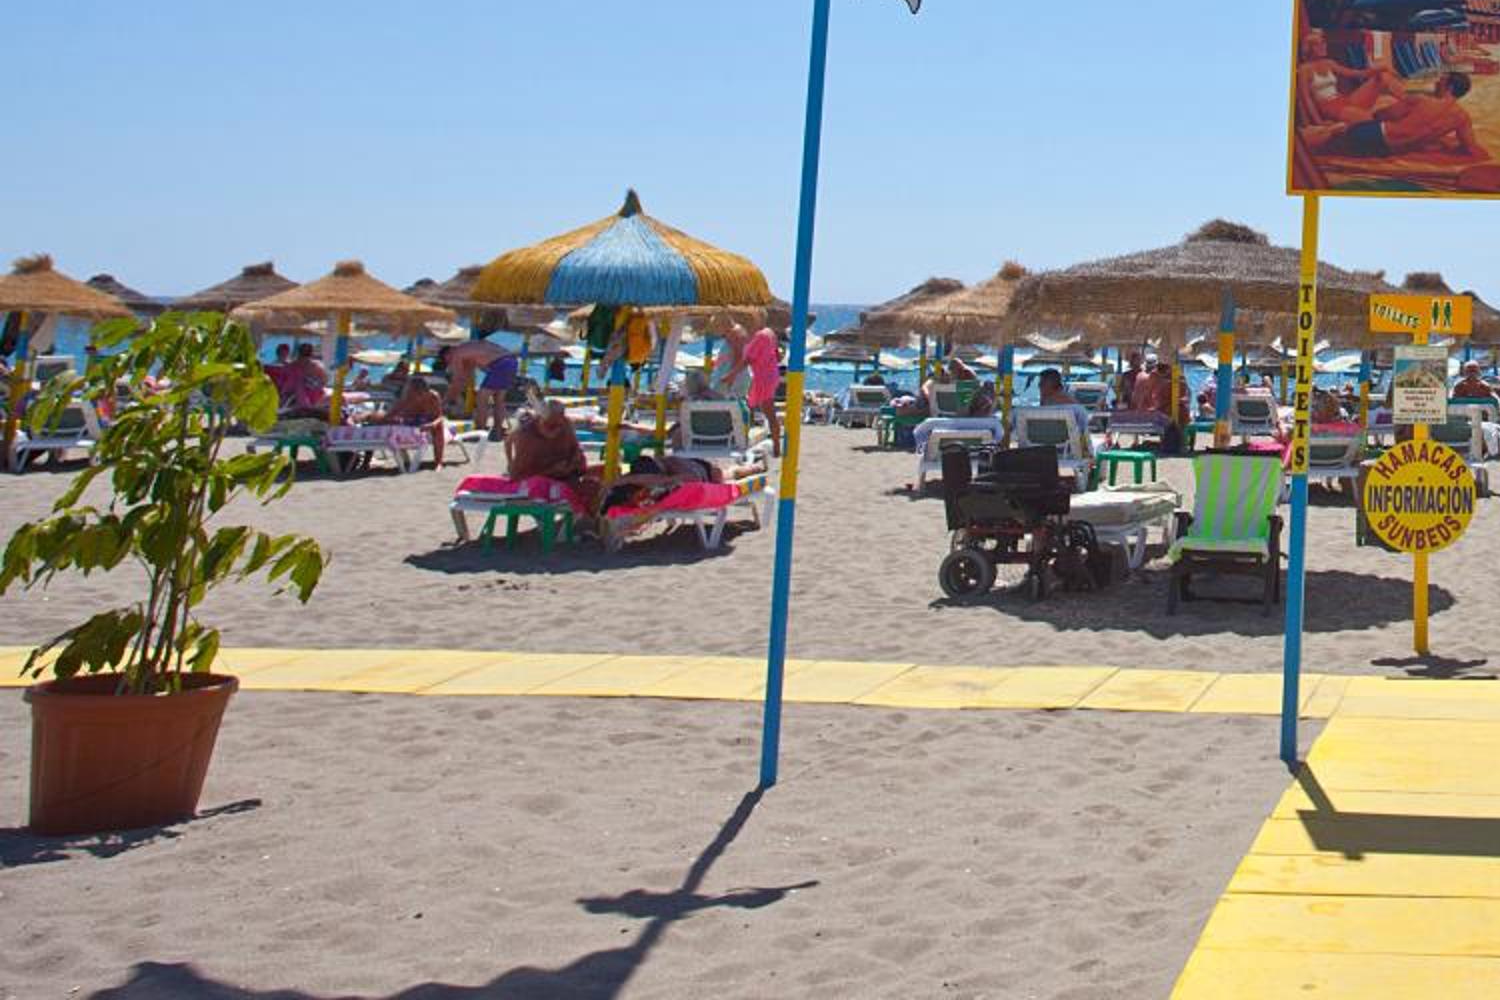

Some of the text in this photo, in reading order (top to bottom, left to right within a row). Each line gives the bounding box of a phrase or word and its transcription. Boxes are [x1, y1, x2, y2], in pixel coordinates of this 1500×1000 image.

[1294, 284, 1313, 468] TOILETS
[1374, 441, 1467, 480] HAMACAS
[1377, 514, 1462, 550] SUNBEDS
